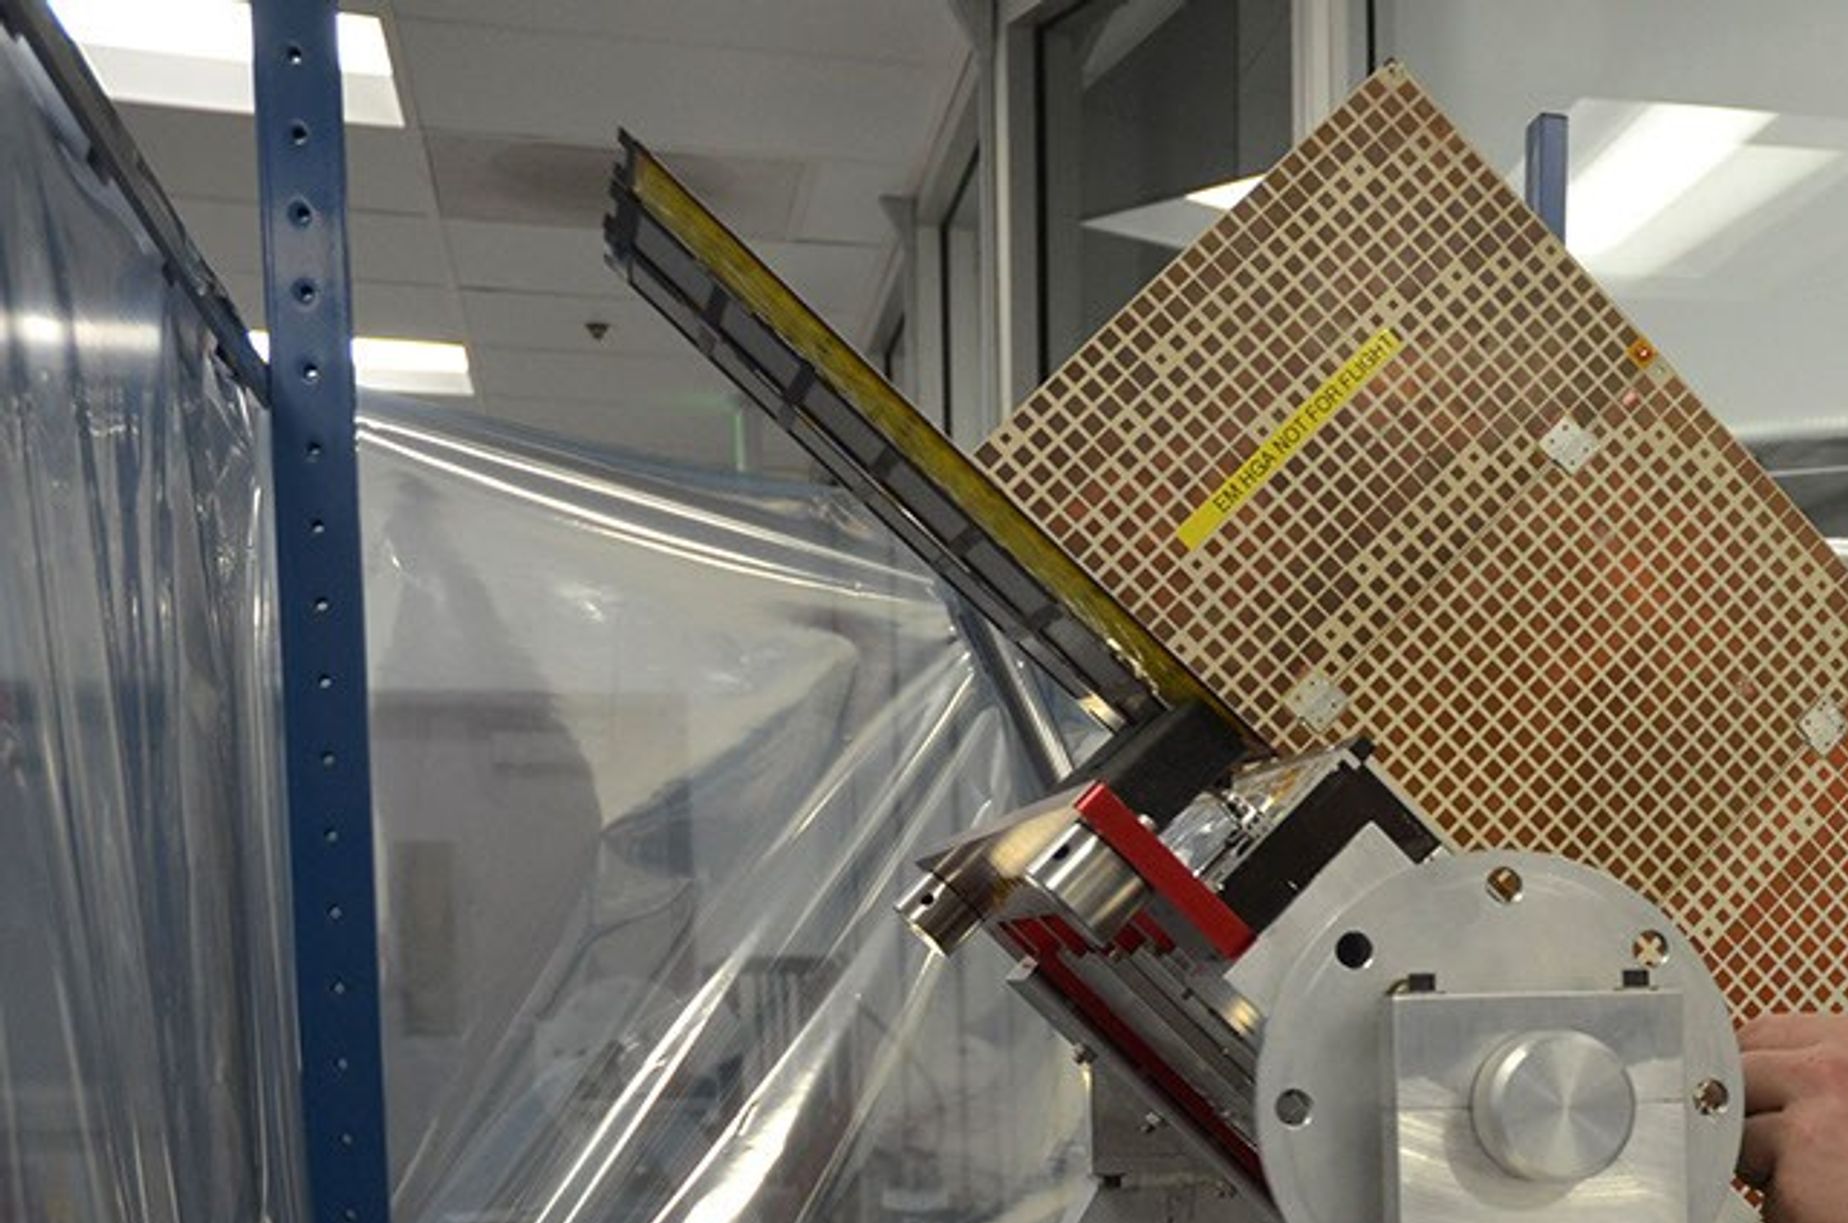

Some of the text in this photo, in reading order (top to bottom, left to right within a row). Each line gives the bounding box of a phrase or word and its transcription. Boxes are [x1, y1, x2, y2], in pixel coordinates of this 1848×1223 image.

[1212, 333, 1394, 513] EM HGA NOT FOR FLIGHT
